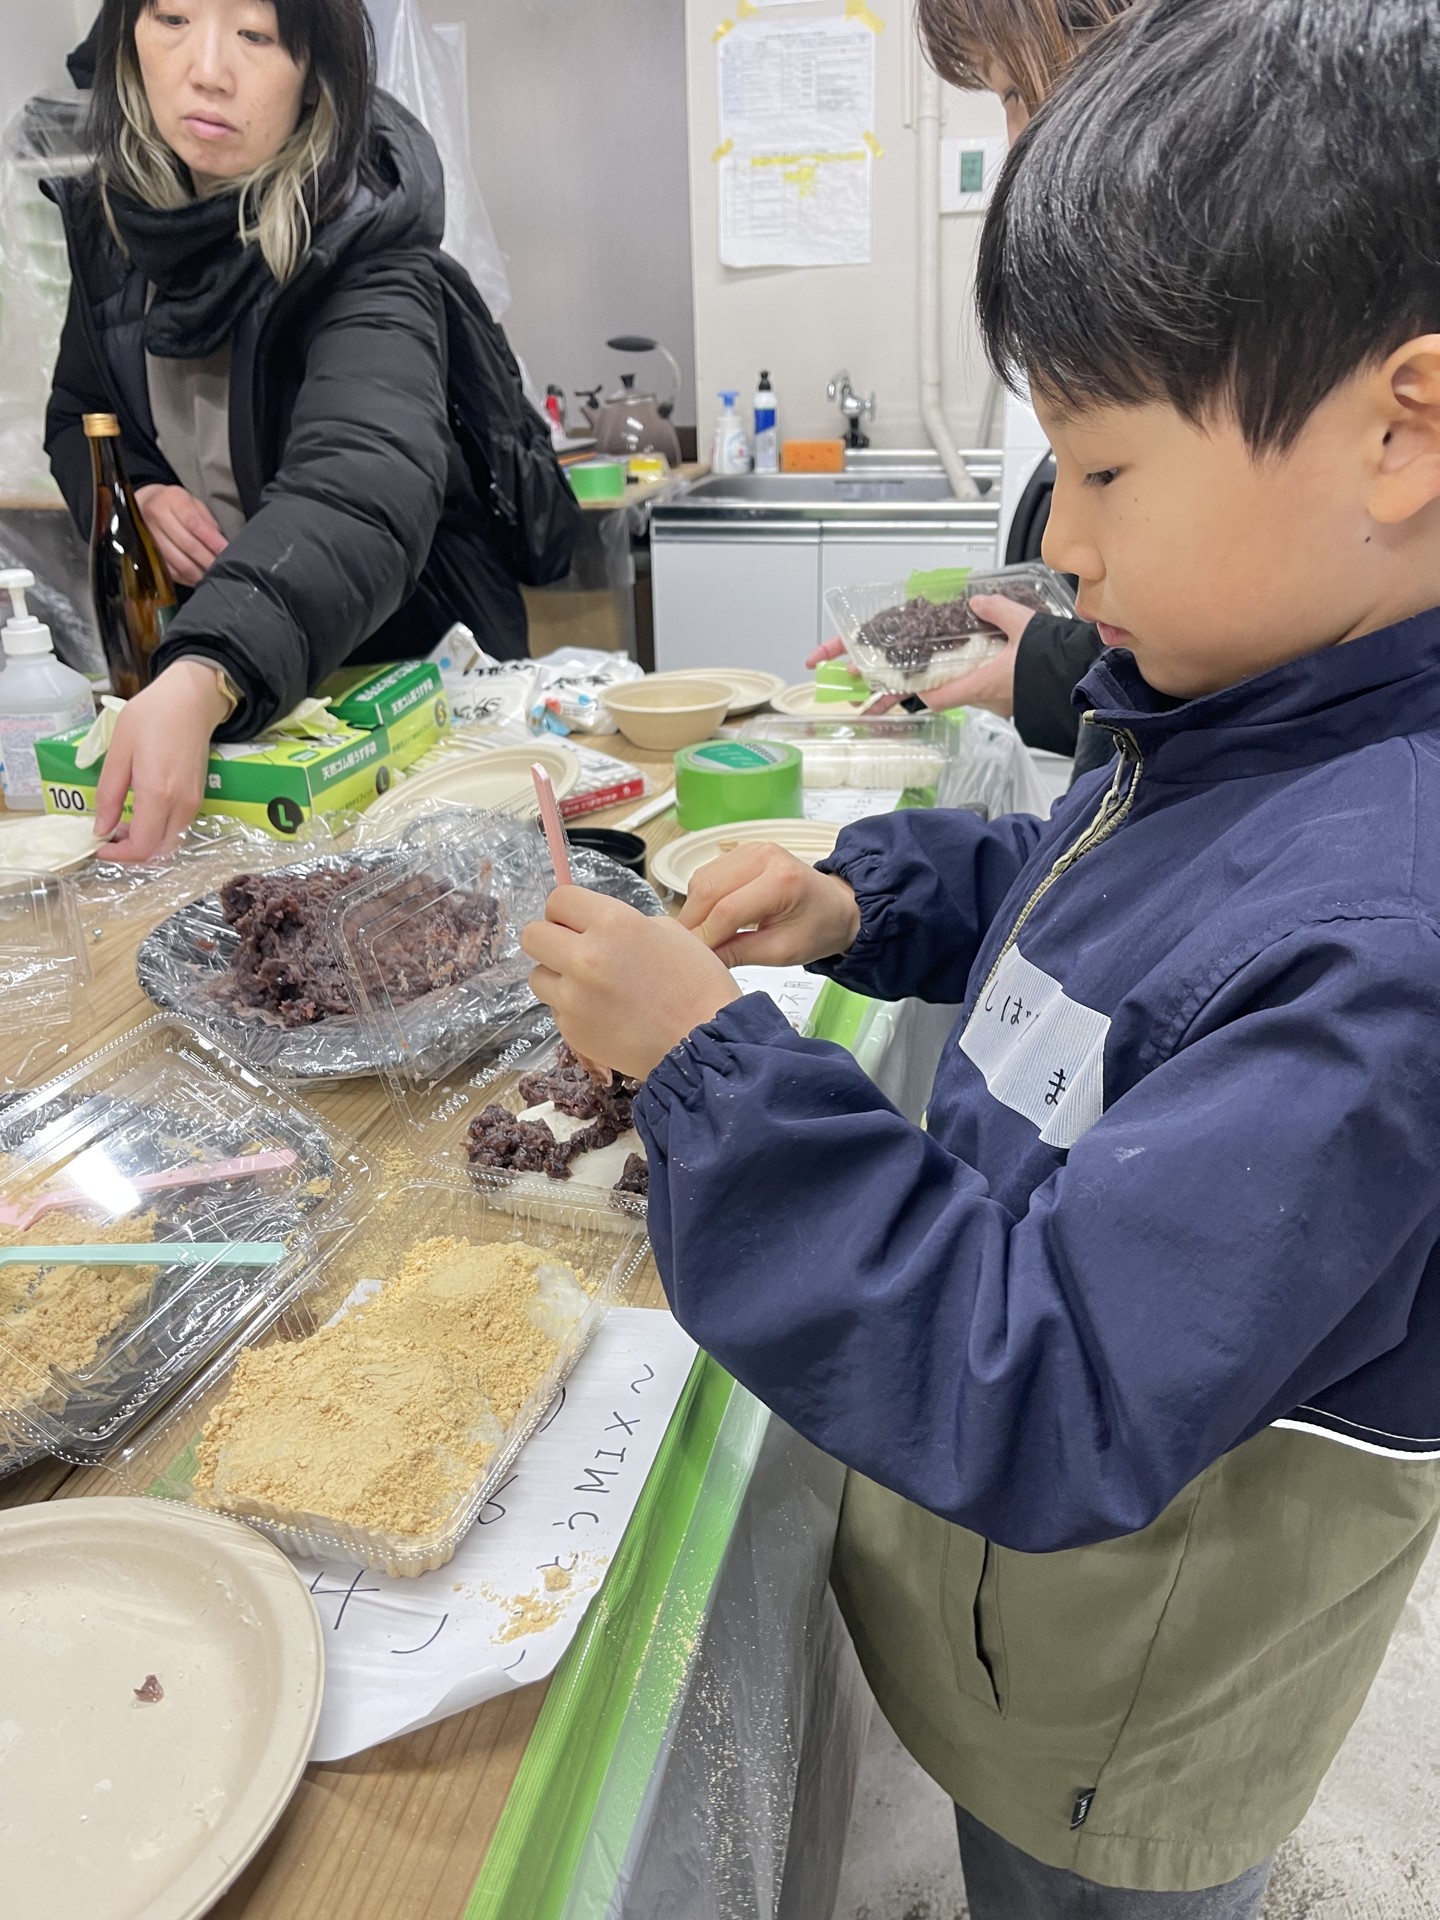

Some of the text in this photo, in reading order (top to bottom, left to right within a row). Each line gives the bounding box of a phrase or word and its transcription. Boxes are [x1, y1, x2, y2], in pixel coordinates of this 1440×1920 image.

[48, 787, 86, 812] 100
[277, 803, 294, 828] L
[984, 980, 1042, 1026] しば
